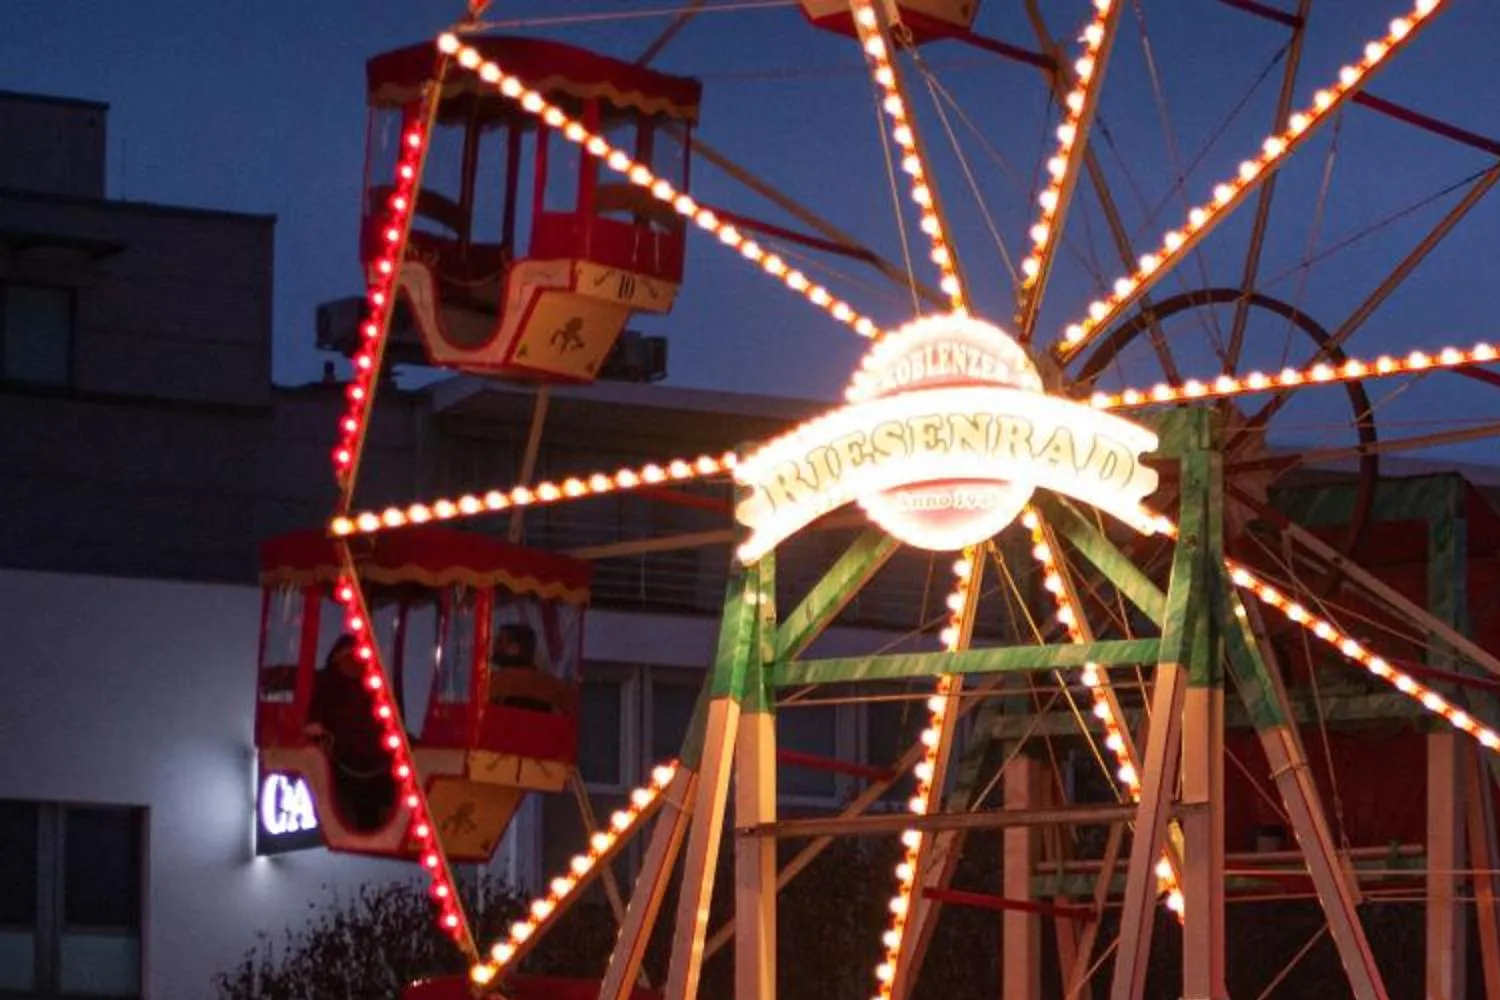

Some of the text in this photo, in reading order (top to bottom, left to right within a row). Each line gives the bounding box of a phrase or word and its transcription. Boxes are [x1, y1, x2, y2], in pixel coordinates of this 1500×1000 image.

[881, 340, 1009, 388] OBLENZER
[757, 411, 1136, 512] RIESENRAD
[901, 491, 951, 508] nno
